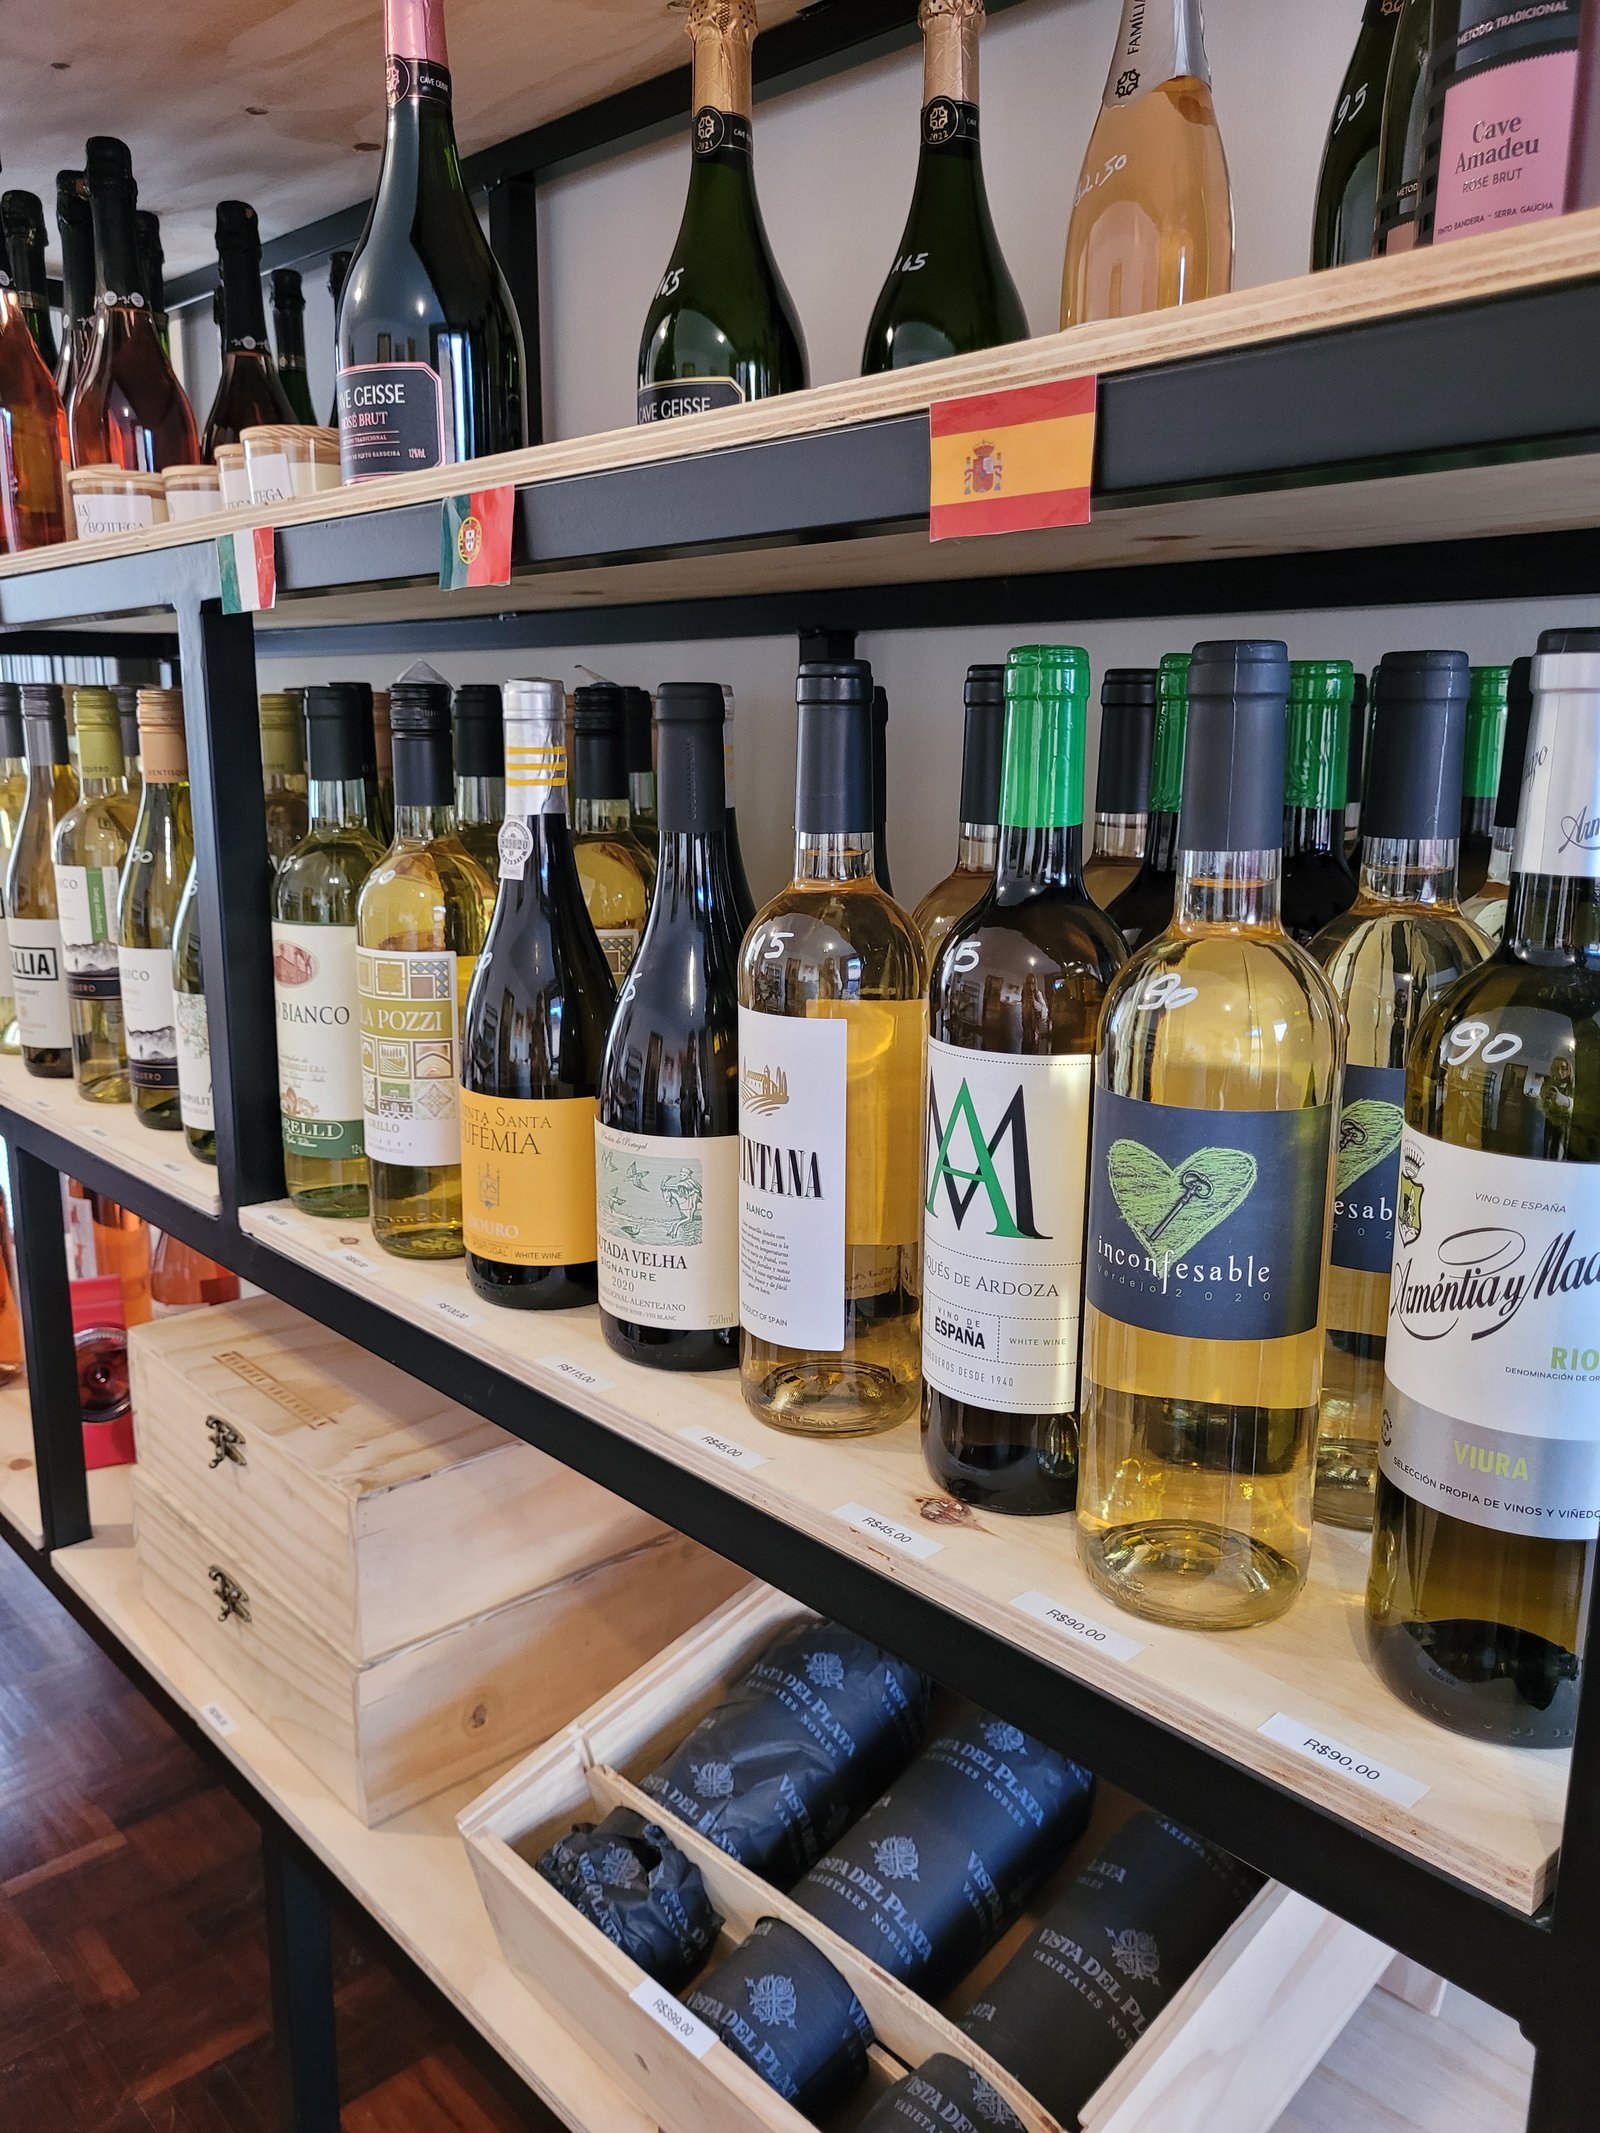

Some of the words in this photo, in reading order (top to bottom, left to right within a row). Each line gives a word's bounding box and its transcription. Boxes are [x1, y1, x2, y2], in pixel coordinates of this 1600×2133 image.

[1494, 1, 1569, 27] TRADICIONAL
[1472, 116, 1522, 143] Cave
[1455, 137, 1539, 174] Amadeu
[1492, 168, 1523, 185] BRUT
[1454, 215, 1485, 231] BANDEIRA
[1494, 208, 1517, 220] SERRA
[354, 384, 406, 407] GEISSE
[359, 411, 388, 428] BRUT
[1137, 972, 1198, 1010] 90
[282, 1003, 350, 1025] BIANCO
[378, 1009, 443, 1031] POZZI
[1447, 1021, 1522, 1066] 90
[745, 1201, 773, 1219] BLANCO
[1475, 1192, 1500, 1204] VINO
[1503, 1198, 1518, 1208] DE
[1521, 1202, 1567, 1214] ESPAÑA
[515, 1251, 539, 1260] WHITE
[541, 1251, 563, 1260] WINE
[629, 1250, 688, 1270] VELHA
[1098, 1235, 1270, 1294] inconfesable
[601, 1256, 657, 1282] SIGNATURE
[1097, 1264, 1156, 1293] Verdejo
[611, 1276, 635, 1292] 2020
[954, 1271, 971, 1288] DE
[975, 1276, 1059, 1298] ARDOZA
[630, 1298, 686, 1312] ALENTEJANO
[937, 1306, 959, 1321] VINO
[966, 1318, 981, 1328] DE
[707, 1313, 734, 1326] 750ml
[759, 1312, 767, 1320] OF
[768, 1315, 788, 1327] SPAIN
[934, 1316, 986, 1350] ESPAÑA
[1009, 1337, 1039, 1346] WHITE
[1042, 1338, 1067, 1346] WINE
[1551, 1347, 1599, 1371] RIO
[958, 1366, 985, 1382] DESDE
[991, 1375, 1014, 1387] 1940
[1505, 1366, 1573, 1381] DENOMINACIÓN
[701, 1435, 743, 1458] R$45,00
[1452, 1440, 1529, 1481] VIURA
[1393, 1456, 1437, 1489] SELECCIÓN
[1439, 1483, 1480, 1504] PROPIA
[1484, 1498, 1500, 1509] DE
[1503, 1502, 1542, 1516] VINOS
[1546, 1509, 1556, 1518] Y
[861, 1516, 912, 1544] R$45,00
[1046, 1608, 1107, 1643] R$90,00
[783, 1673, 813, 1706] DEL
[811, 1697, 856, 1757] PLATA
[1302, 1737, 1381, 1782] R$90,00
[959, 1743, 995, 1773] DEL
[994, 1761, 1044, 1828] PLATA
[668, 1787, 700, 1820] DEL
[984, 1779, 1026, 1828] NOBLES
[847, 1865, 885, 1902] DEL
[882, 1891, 933, 1964] PLATA
[871, 1912, 913, 1965] NOBLES
[1038, 1928, 1083, 1966] VISTA
[1081, 1956, 1121, 2003] DEL
[1033, 1949, 1103, 2010] VARIETALES
[721, 2008, 757, 2052] DEL
